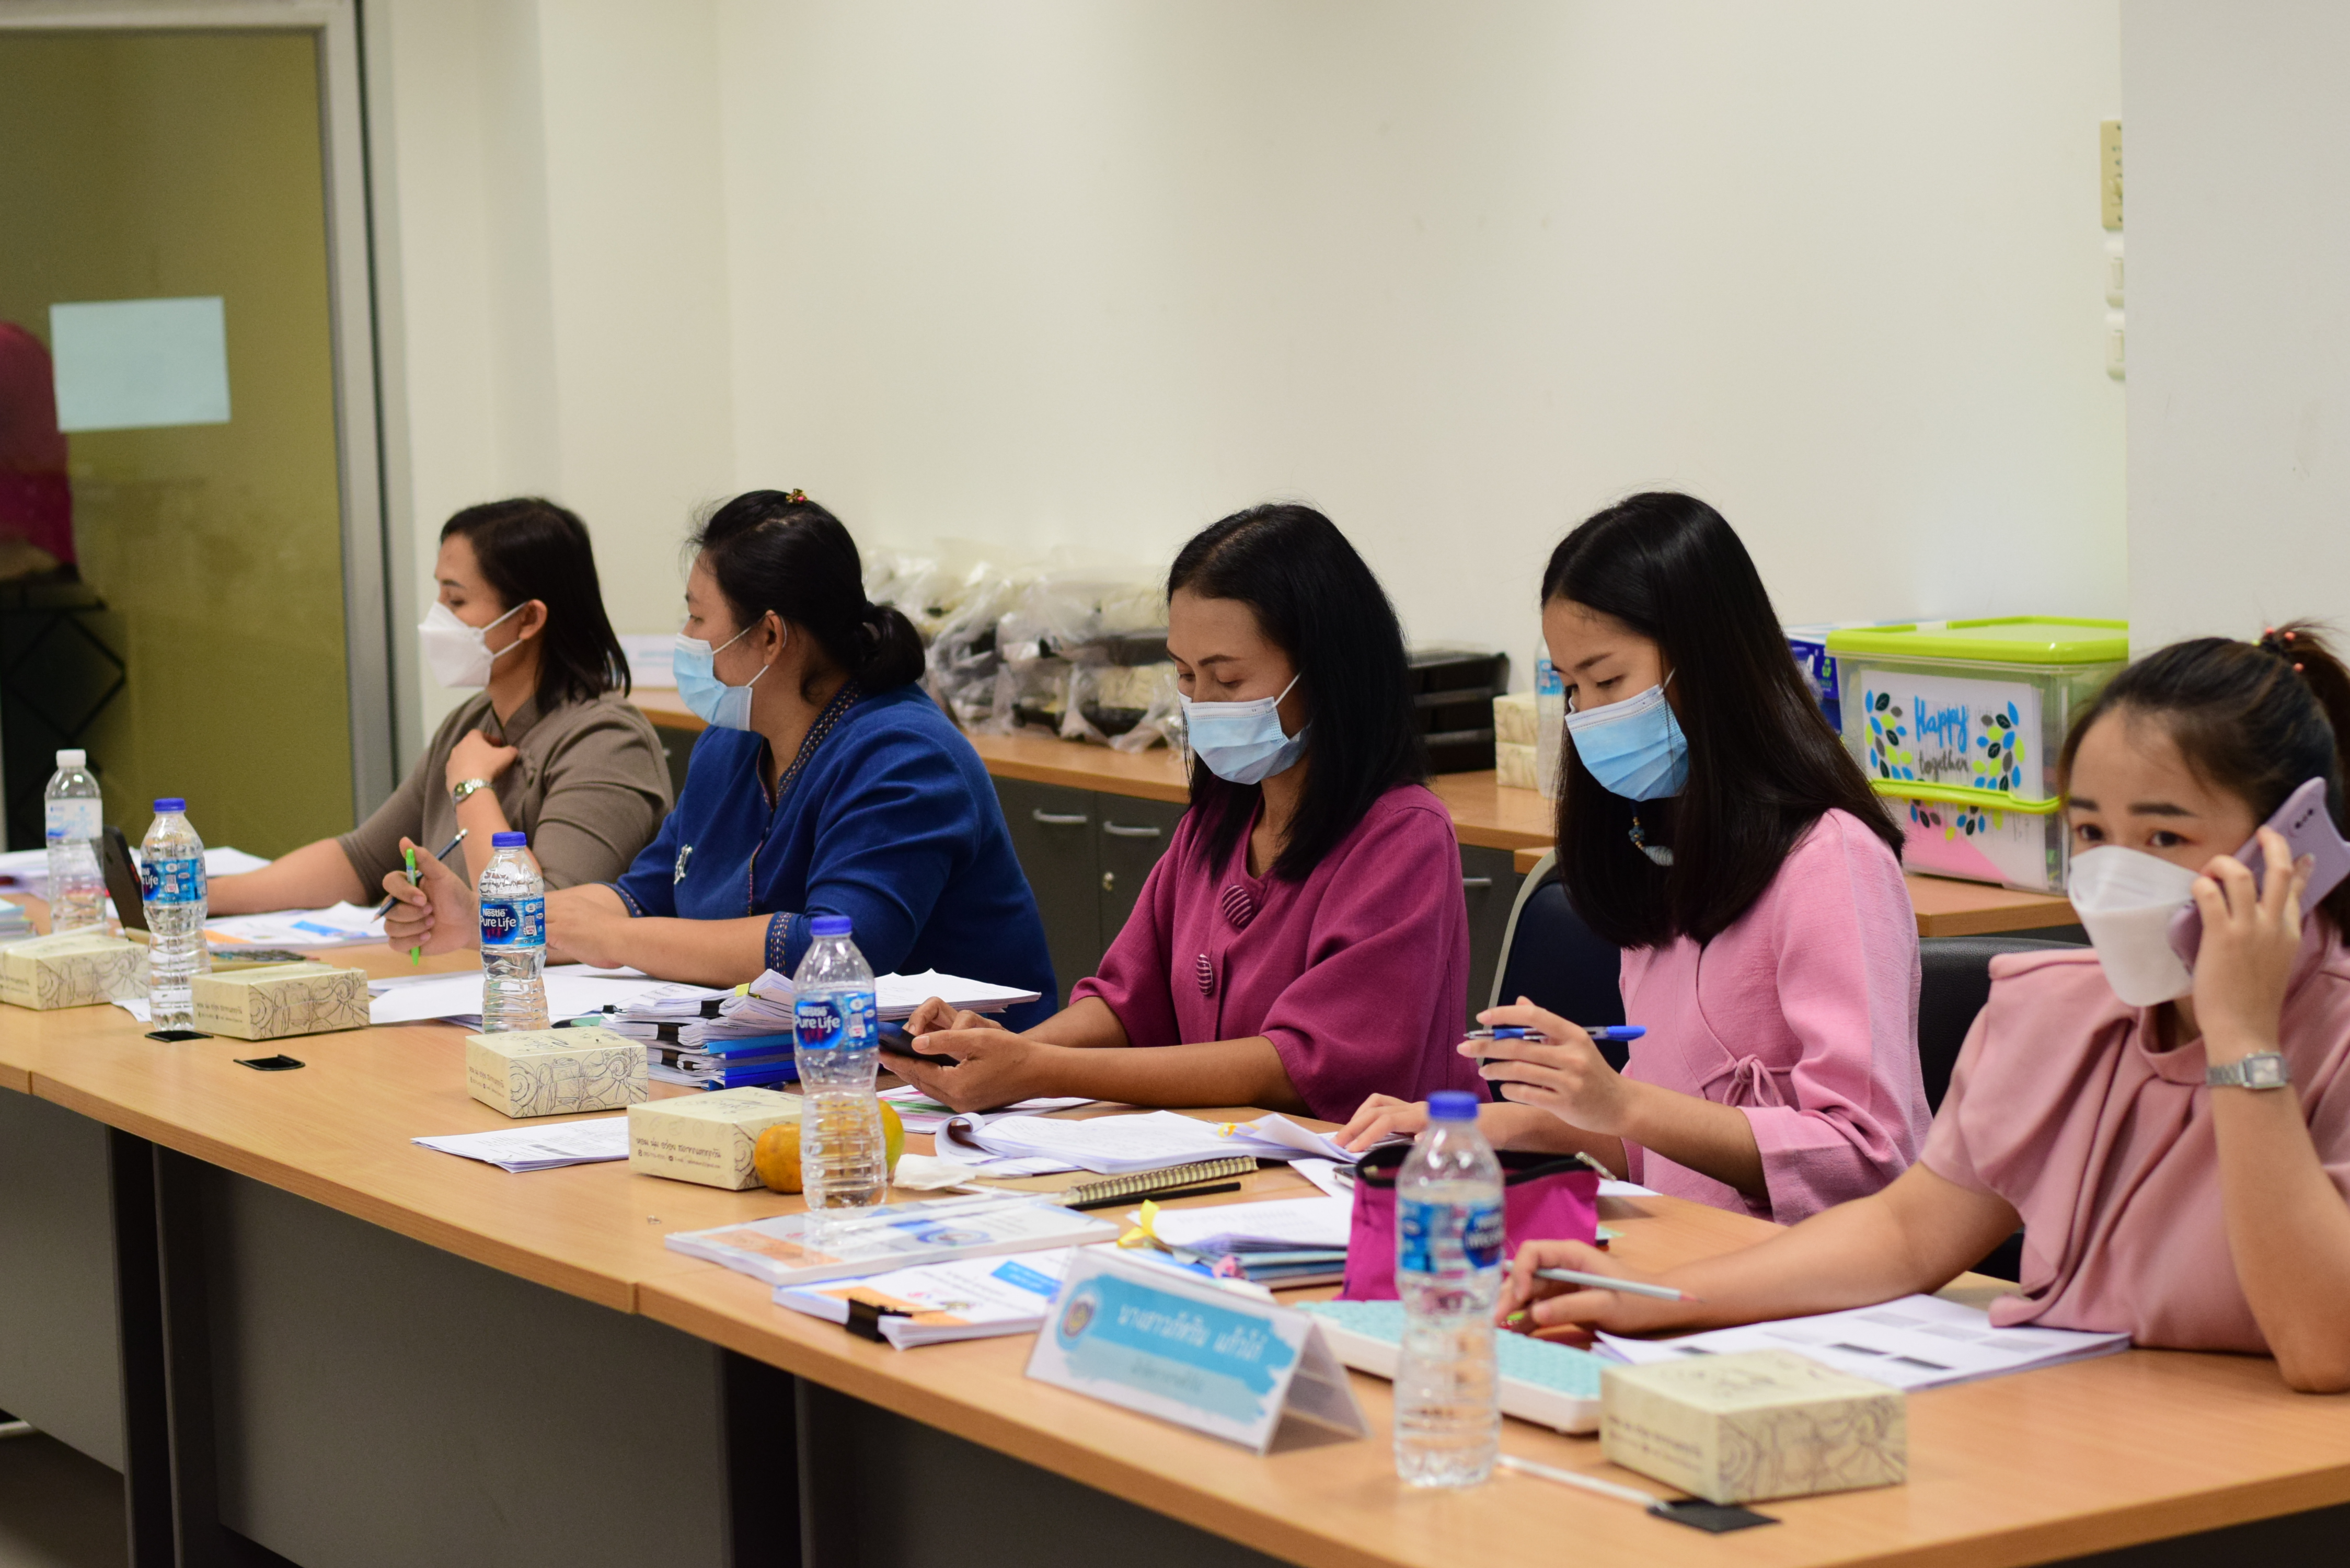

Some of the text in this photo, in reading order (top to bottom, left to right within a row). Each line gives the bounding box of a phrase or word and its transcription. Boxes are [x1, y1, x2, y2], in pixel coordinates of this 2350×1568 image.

[1914, 695, 1969, 753] Happy
[1919, 749, 1969, 782] together
[480, 915, 497, 927] Pure
[498, 917, 516, 931] Life
[794, 1015, 840, 1033] Pure Life
